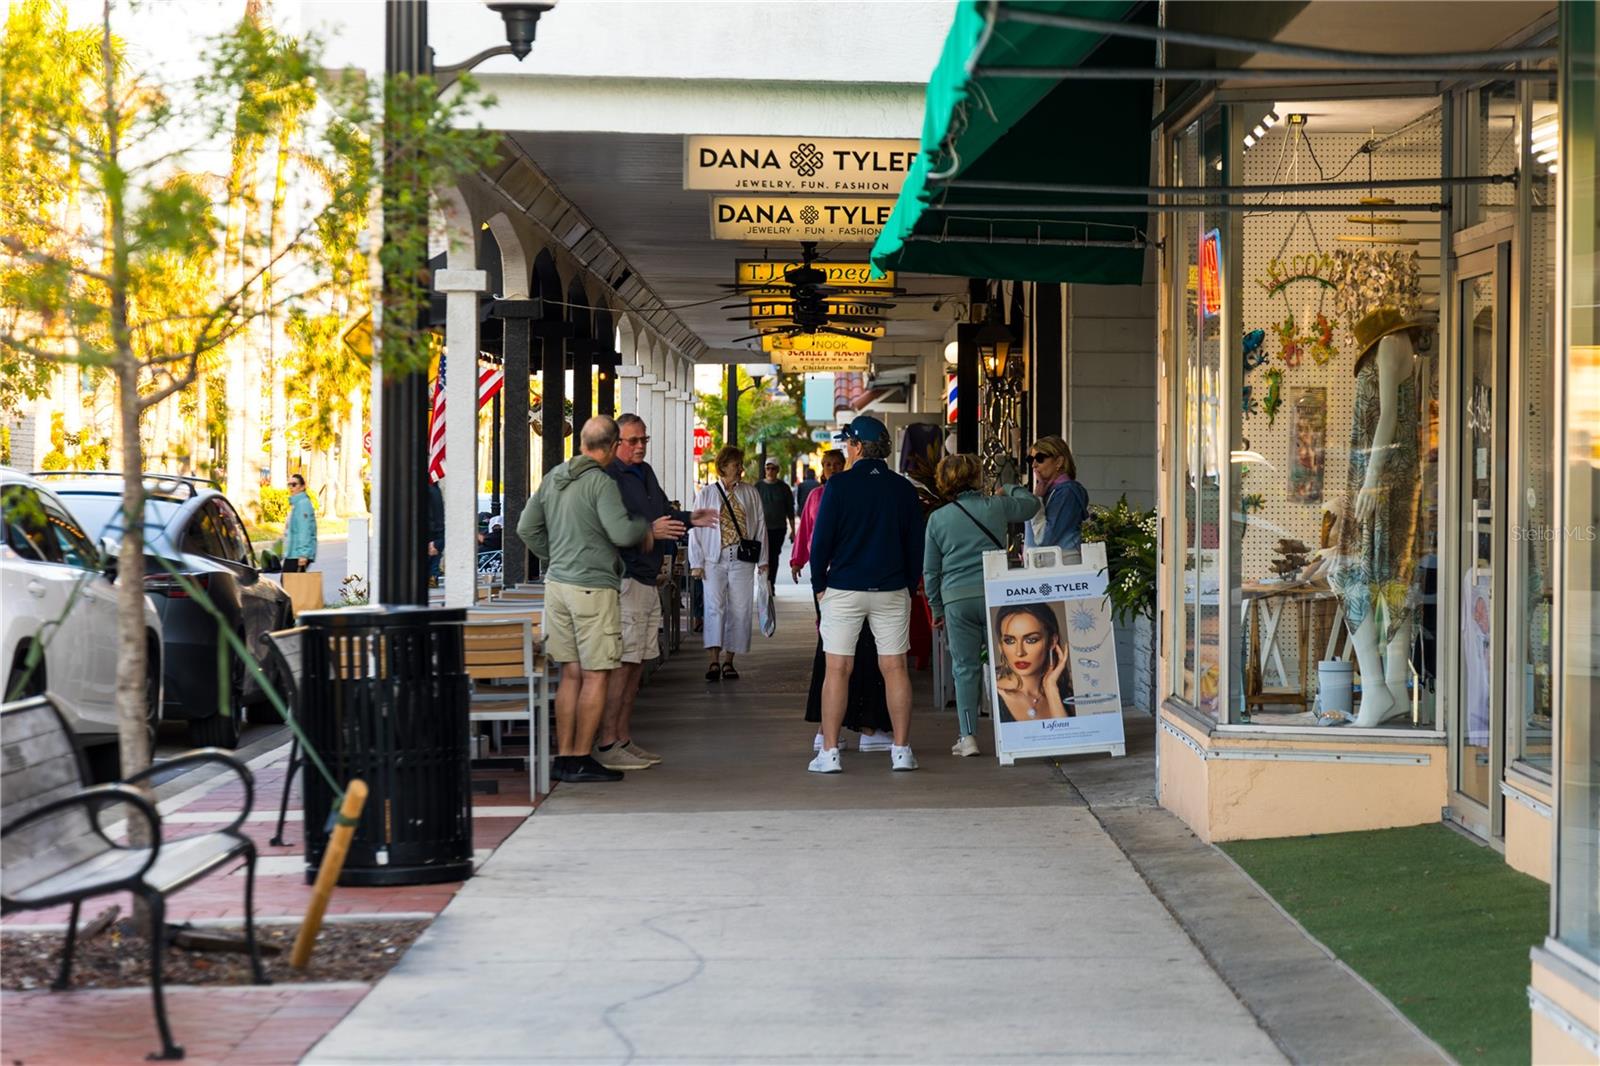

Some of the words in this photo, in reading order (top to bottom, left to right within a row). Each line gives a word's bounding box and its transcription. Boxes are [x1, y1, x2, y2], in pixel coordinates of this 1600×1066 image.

[700, 148, 781, 169] DANA
[736, 180, 795, 189] JEWELRY.
[835, 182, 889, 190] FASHION
[719, 205, 795, 224] DANA
[747, 227, 792, 235] JEWELRY
[816, 341, 849, 350] NOOK
[694, 436, 711, 448] TOP
[1006, 587, 1037, 597] DANA
[1055, 582, 1089, 593] TYLER
